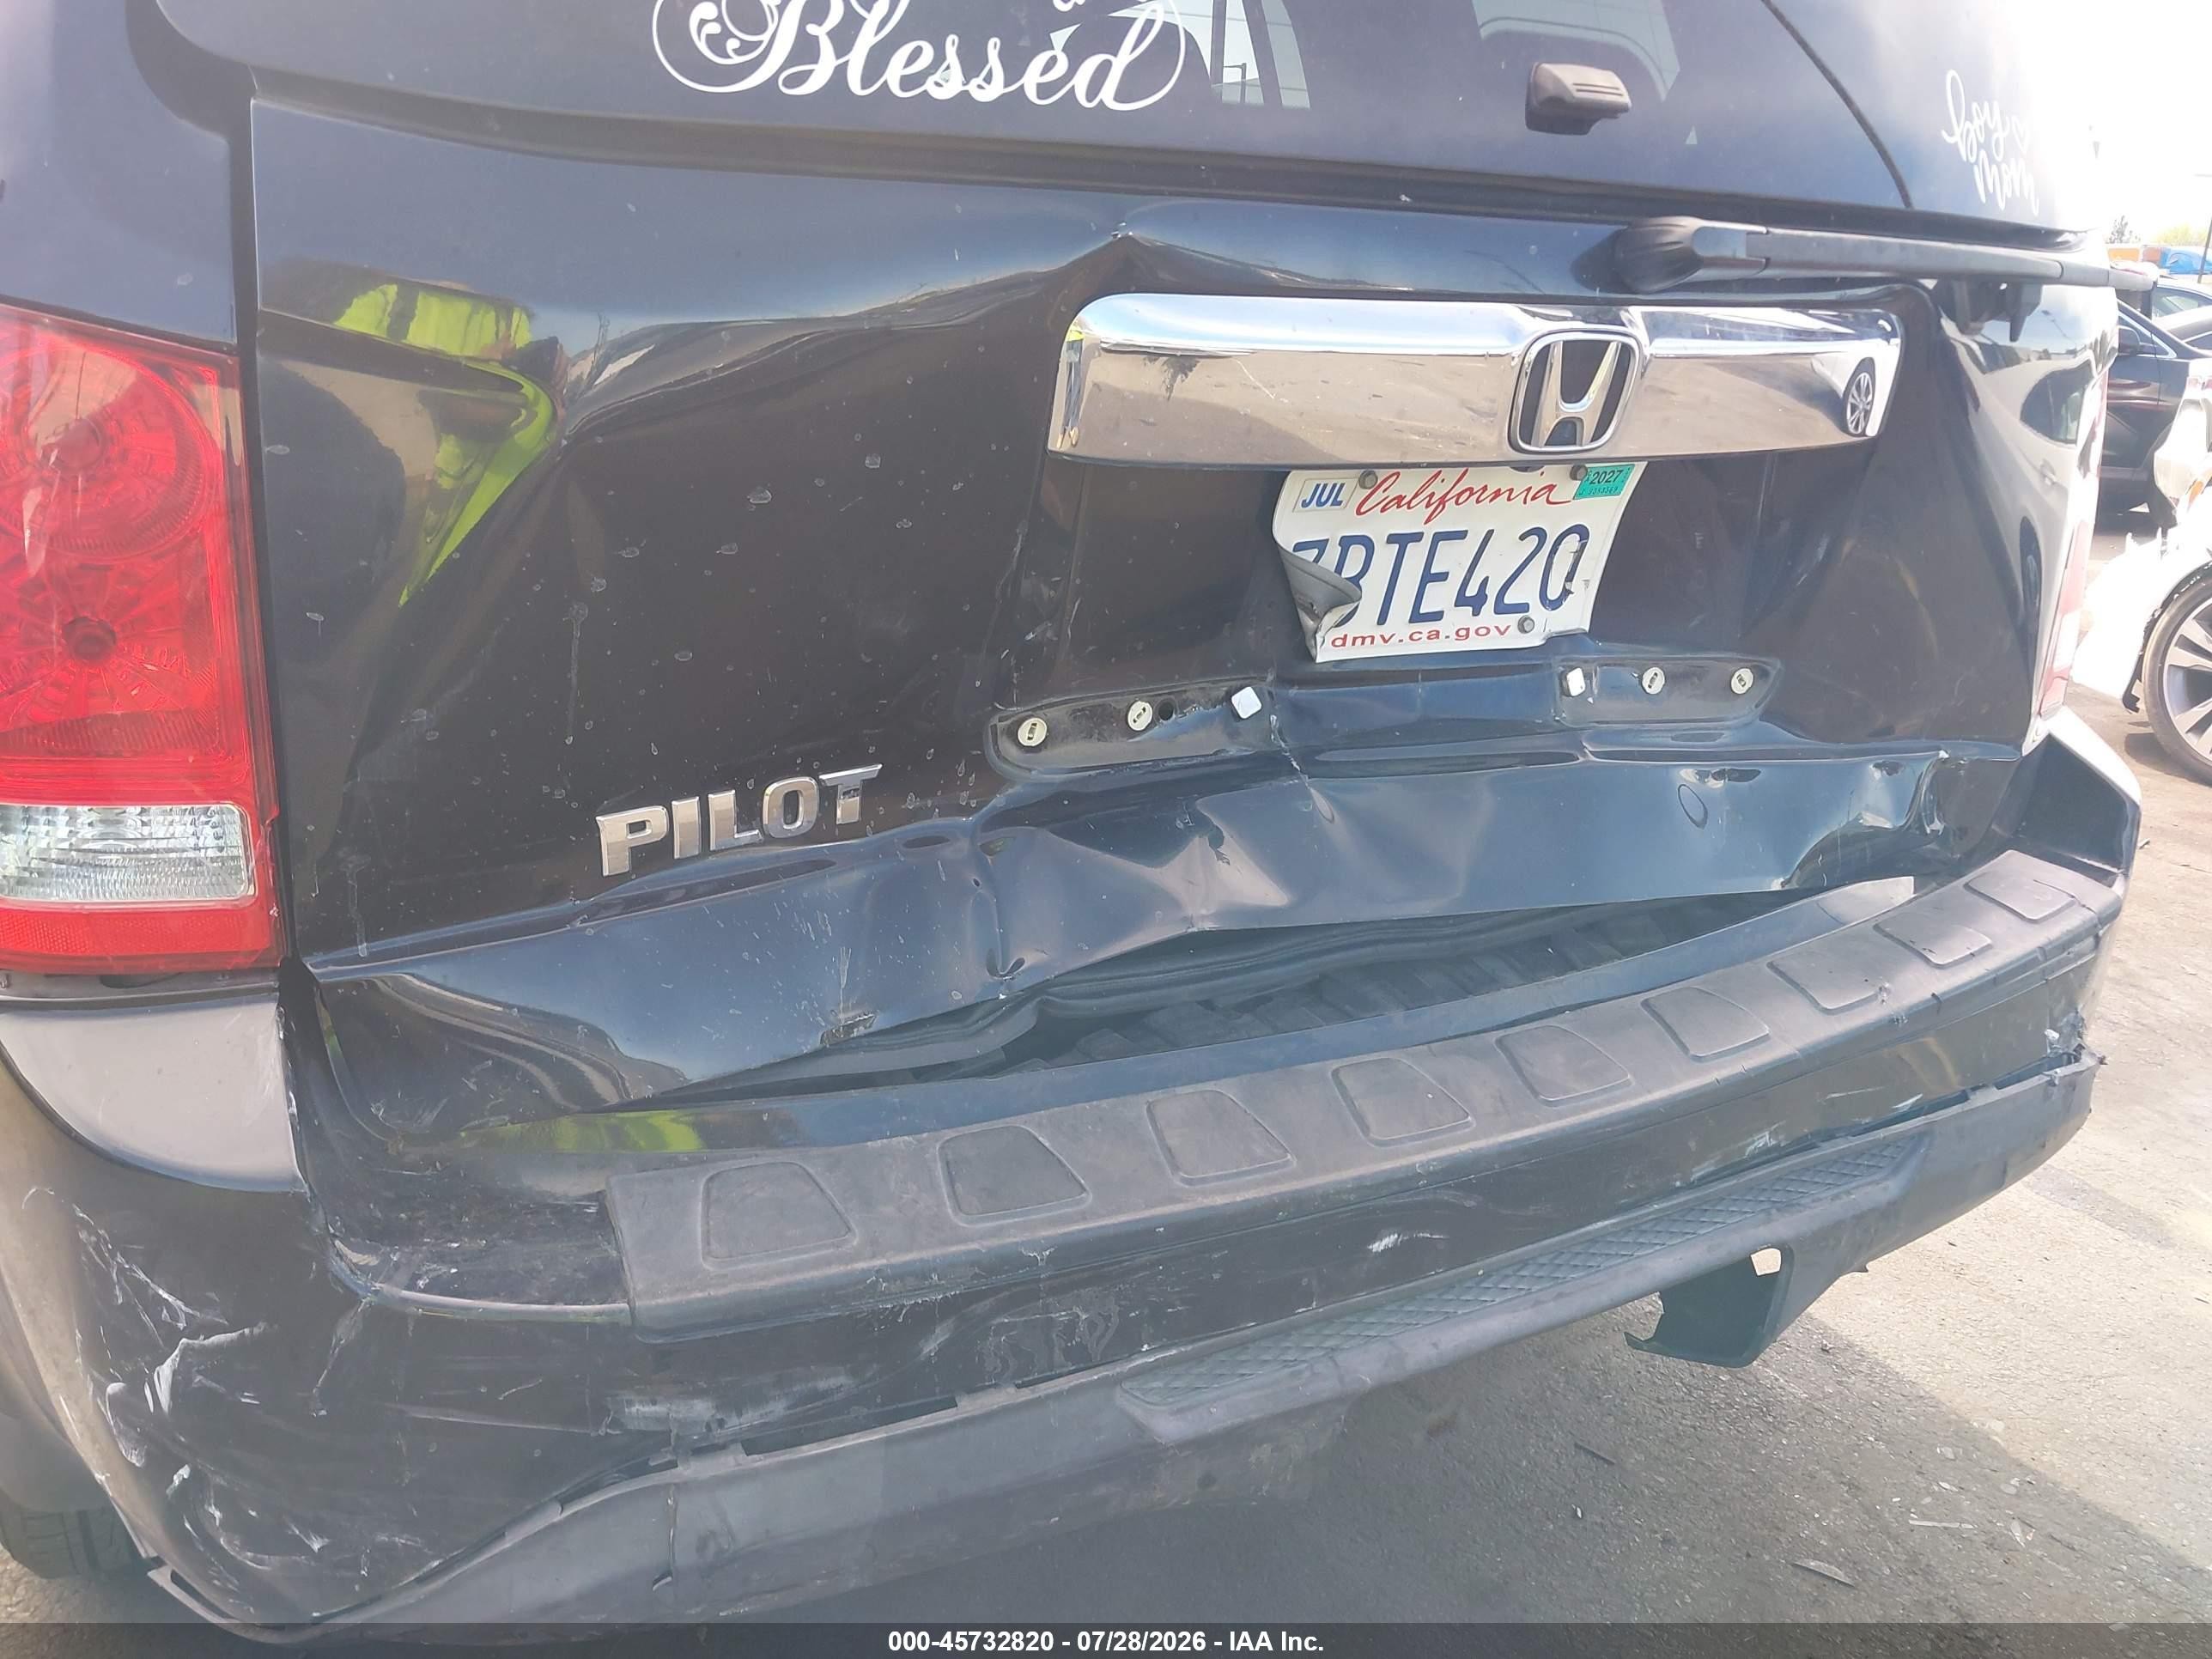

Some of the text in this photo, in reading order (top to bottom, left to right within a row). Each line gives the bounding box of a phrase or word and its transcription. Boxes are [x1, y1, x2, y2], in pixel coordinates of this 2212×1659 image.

[653, 0, 1186, 111] Blessed
[1301, 483, 1346, 508] JUL
[1356, 468, 1572, 525] California
[1589, 470, 1624, 485] 2027
[1331, 625, 1511, 647] dmv.ca.gov
[595, 763, 883, 877] PILOT
